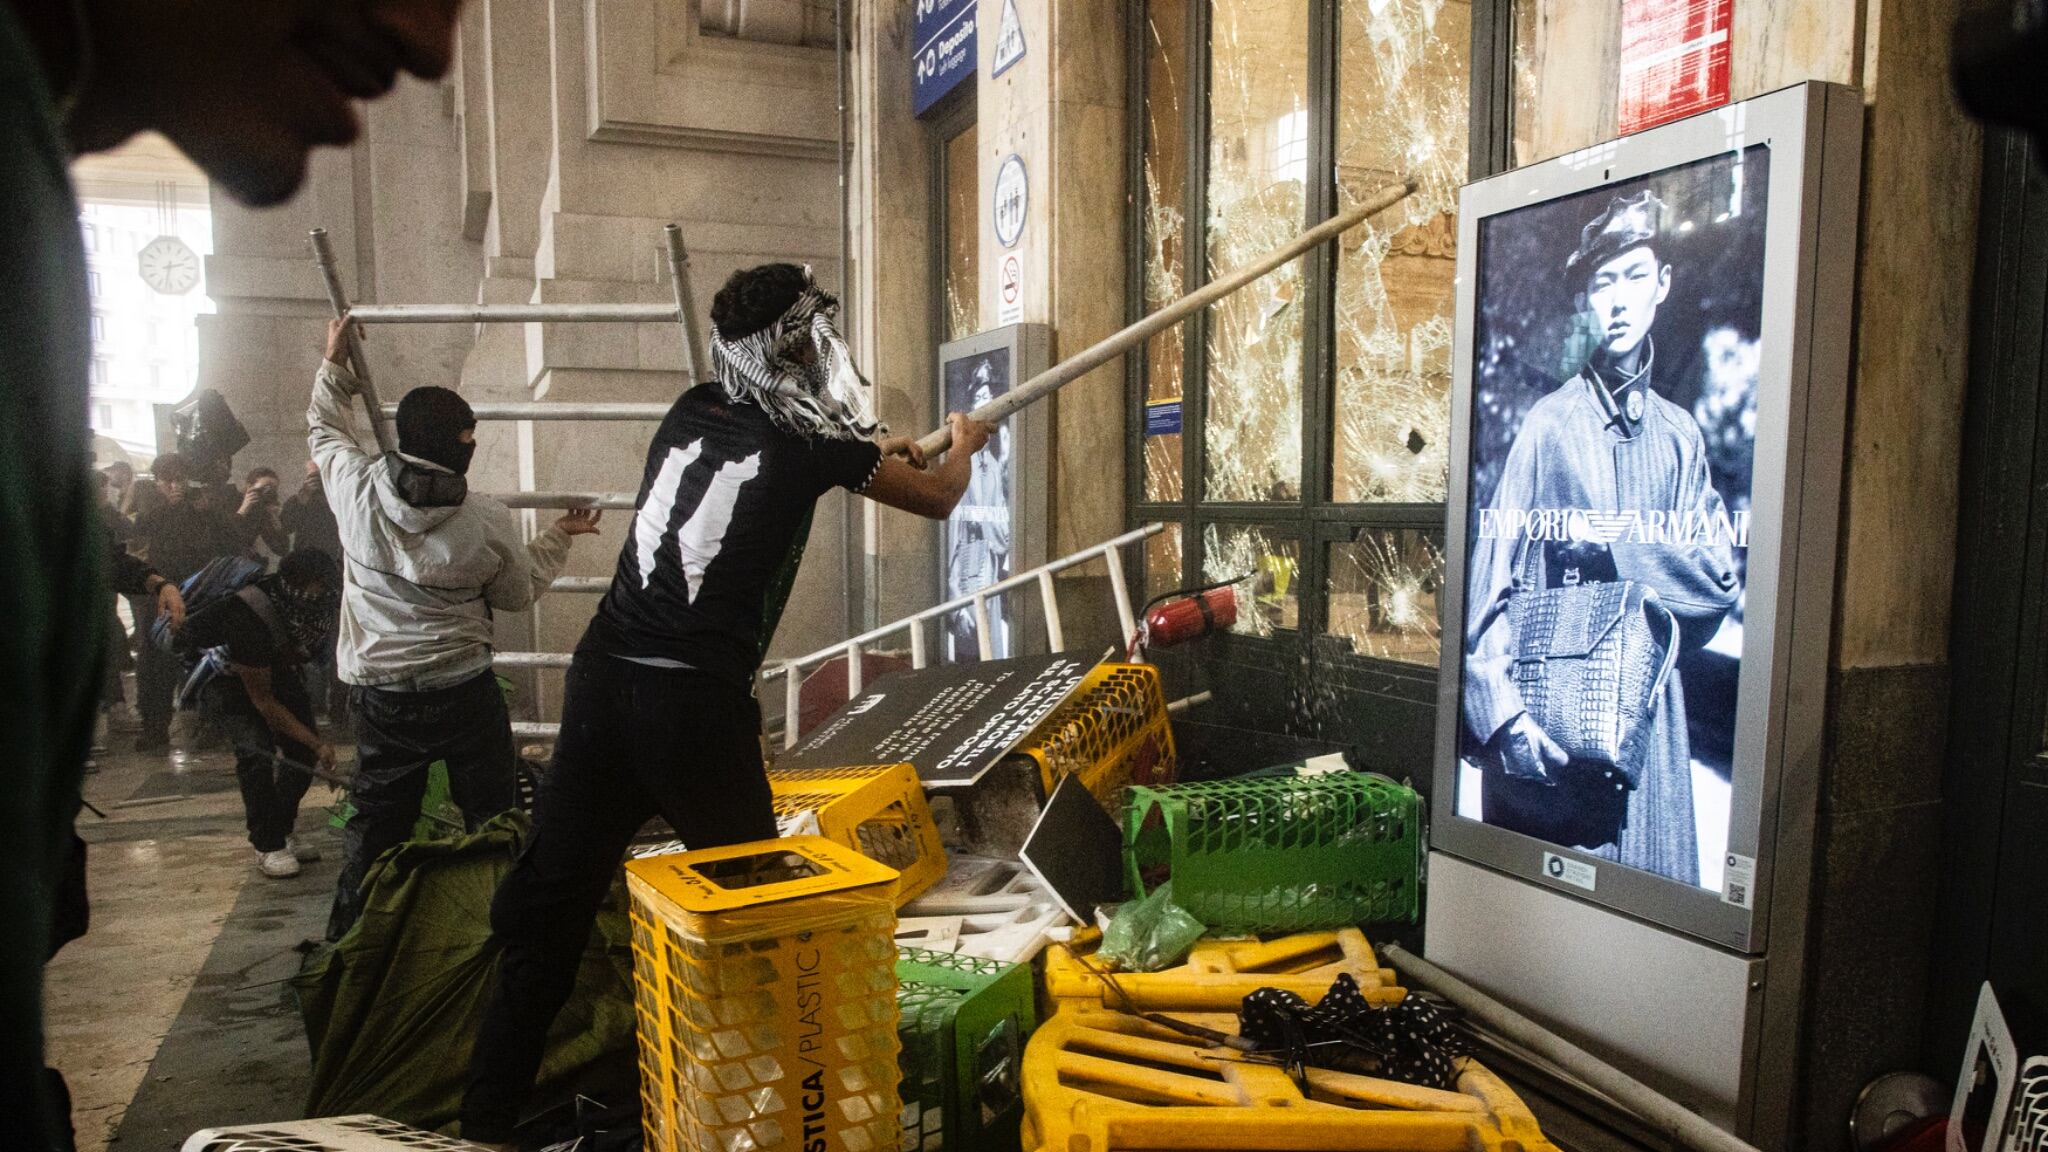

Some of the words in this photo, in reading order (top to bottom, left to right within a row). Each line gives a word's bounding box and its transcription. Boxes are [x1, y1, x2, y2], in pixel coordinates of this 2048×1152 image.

[1477, 508, 1590, 542] EMPORIO
[1624, 509, 1750, 547] ARMANI
[996, 671, 1015, 682] To
[1036, 659, 1067, 680] SUL
[1057, 662, 1081, 677] LE
[902, 686, 954, 727] opposite
[945, 682, 984, 714] please
[962, 684, 997, 711] reach
[1003, 681, 1042, 710] LATO
[1012, 679, 1061, 717] SCALE
[941, 713, 964, 730] the
[993, 675, 1083, 749] UTILIZZARE
[899, 736, 922, 753] the
[900, 727, 917, 741] on
[936, 712, 1006, 769] OPPOSTO
[955, 719, 1017, 767] MOBILI
[877, 743, 900, 760] the
